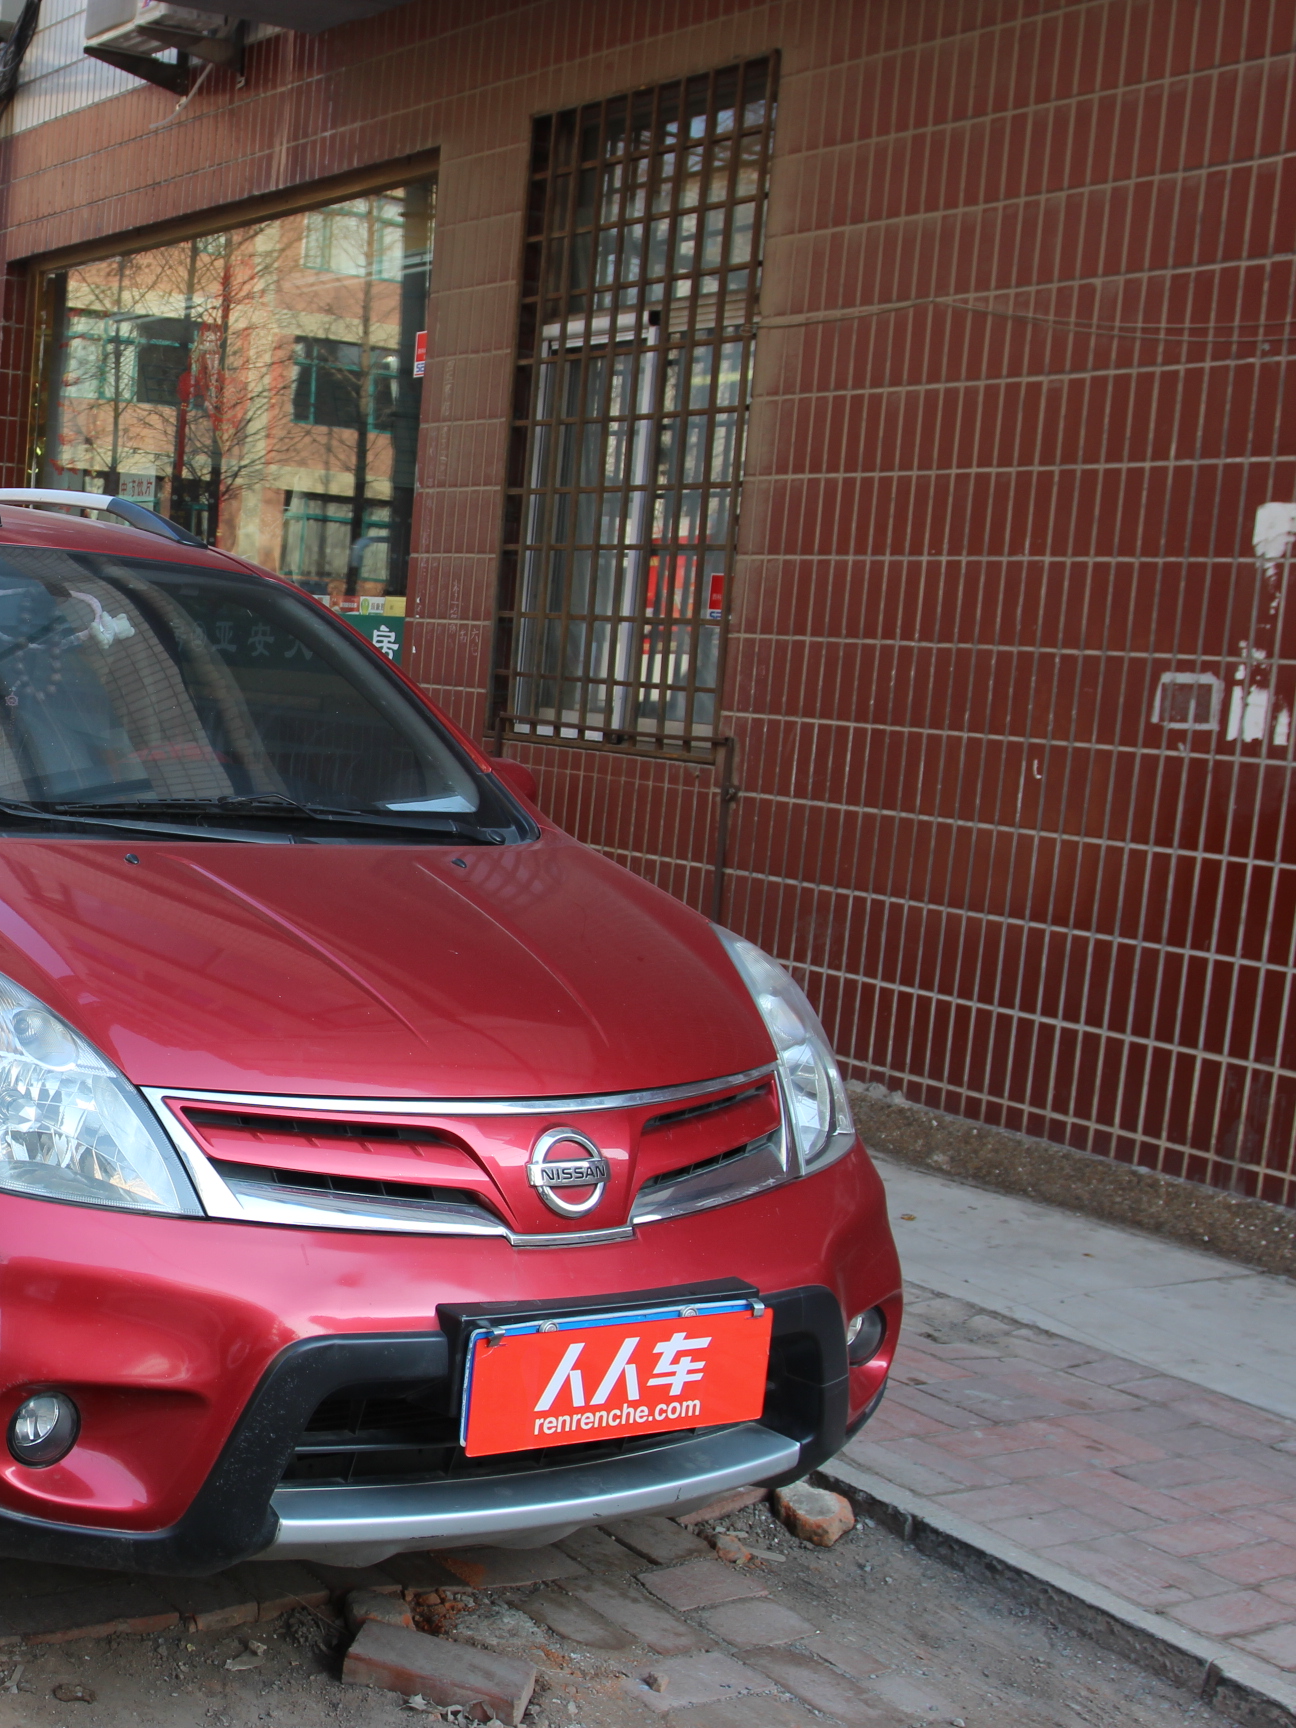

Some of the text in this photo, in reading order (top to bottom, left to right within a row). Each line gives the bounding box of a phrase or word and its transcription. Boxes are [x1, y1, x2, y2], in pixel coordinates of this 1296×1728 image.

[541, 1165, 607, 1181] NISSAN
[534, 1332, 713, 1412] 人人车
[533, 1399, 701, 1436] renrenche.com
